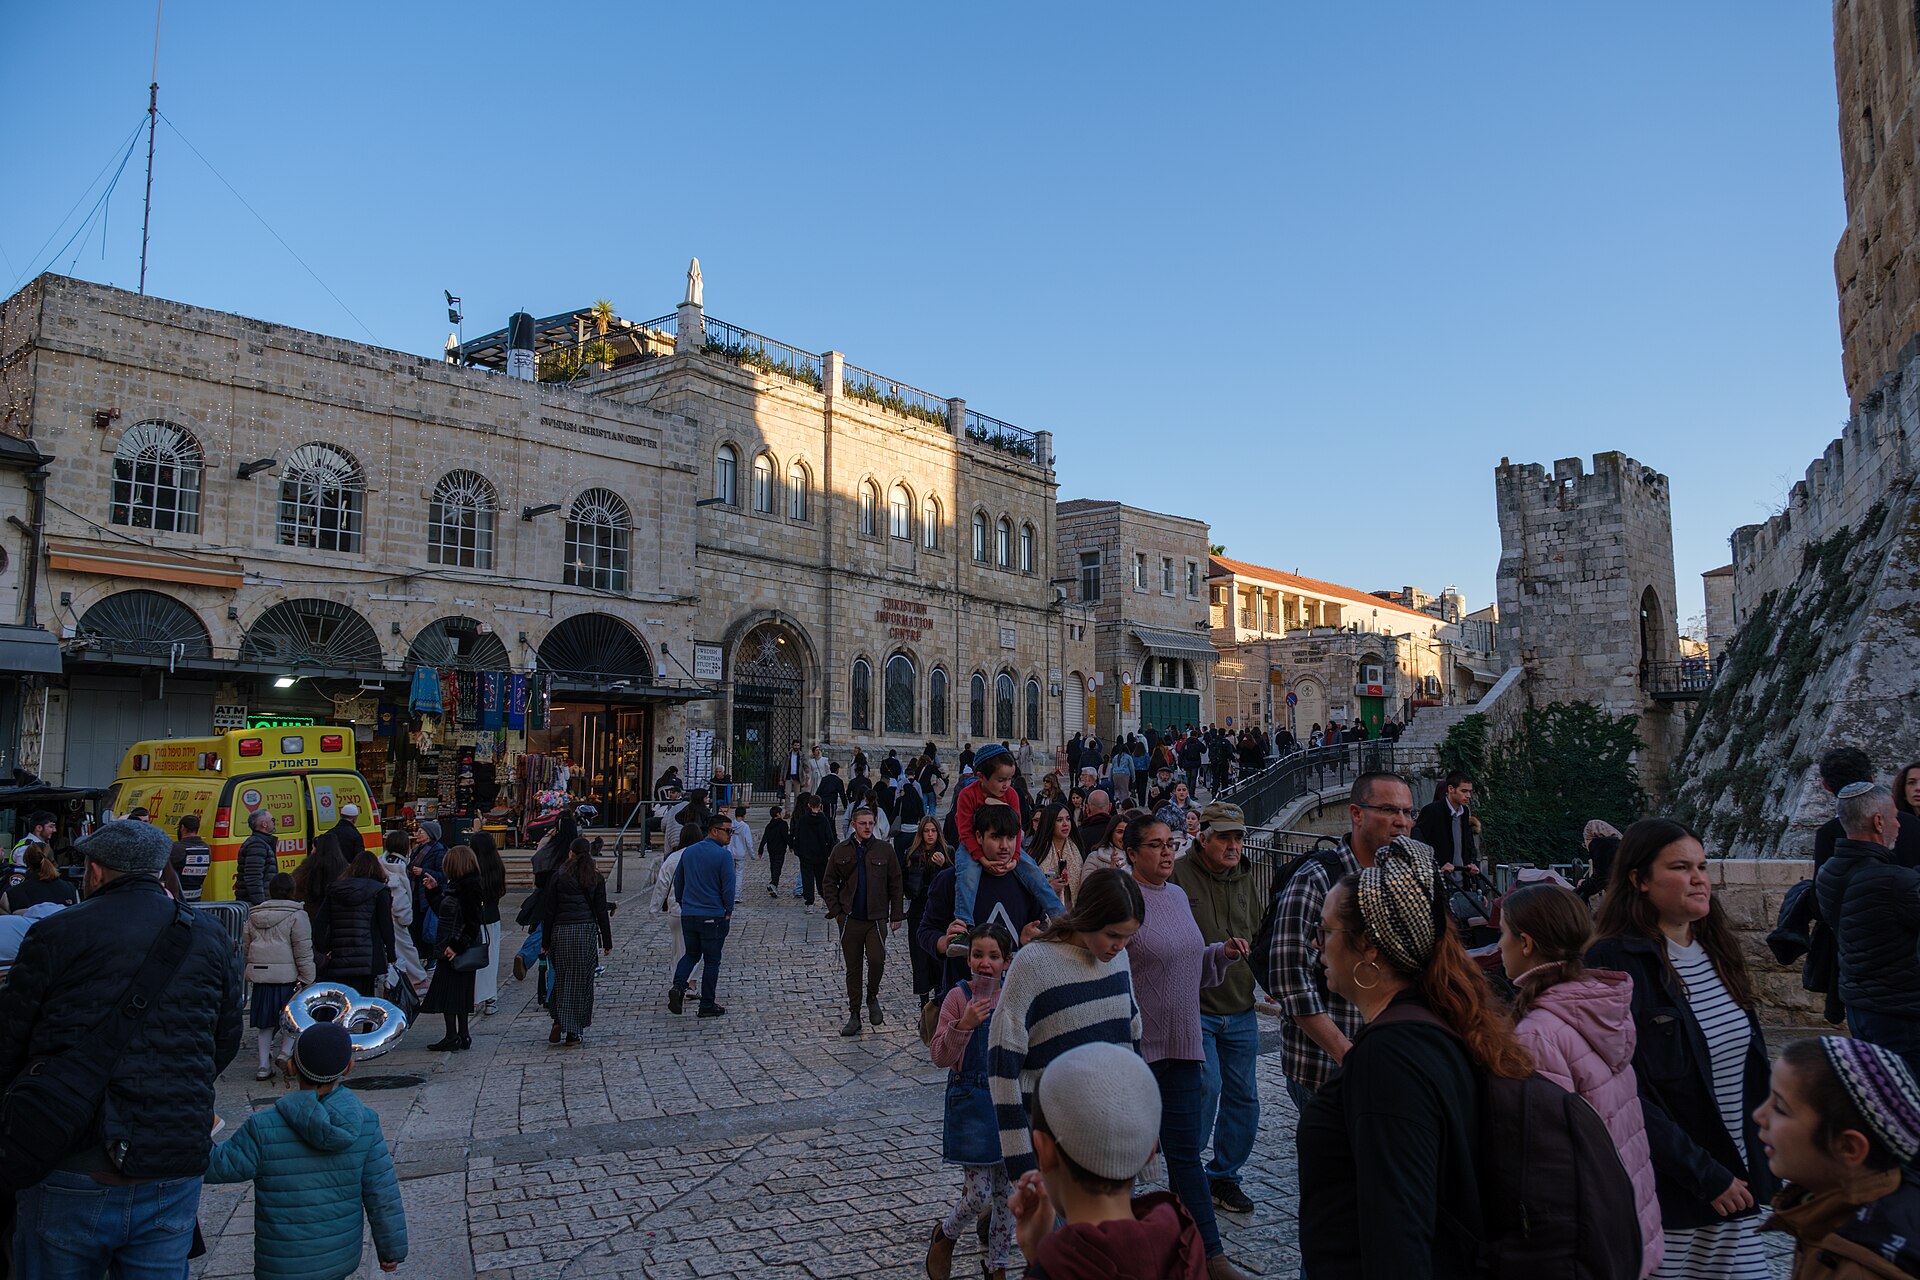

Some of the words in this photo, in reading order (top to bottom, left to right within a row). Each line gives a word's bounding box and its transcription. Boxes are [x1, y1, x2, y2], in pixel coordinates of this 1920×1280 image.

[540, 416, 577, 433] SWEDISH
[579, 425, 624, 442] CHRISTIAN
[625, 434, 658, 449] CENTER
[882, 597, 928, 615] CHRISTIAN
[874, 610, 934, 630] INFORMATION
[888, 627, 922, 642] CENTRE
[696, 654, 722, 662] CHRISTIAN
[215, 706, 245, 714] ATM
[658, 744, 684, 753] baidun
[269, 758, 319, 769] פראמדיק
[266, 793, 293, 802] הורידו
[336, 794, 361, 804] מציל
[281, 859, 296, 869] מגן
